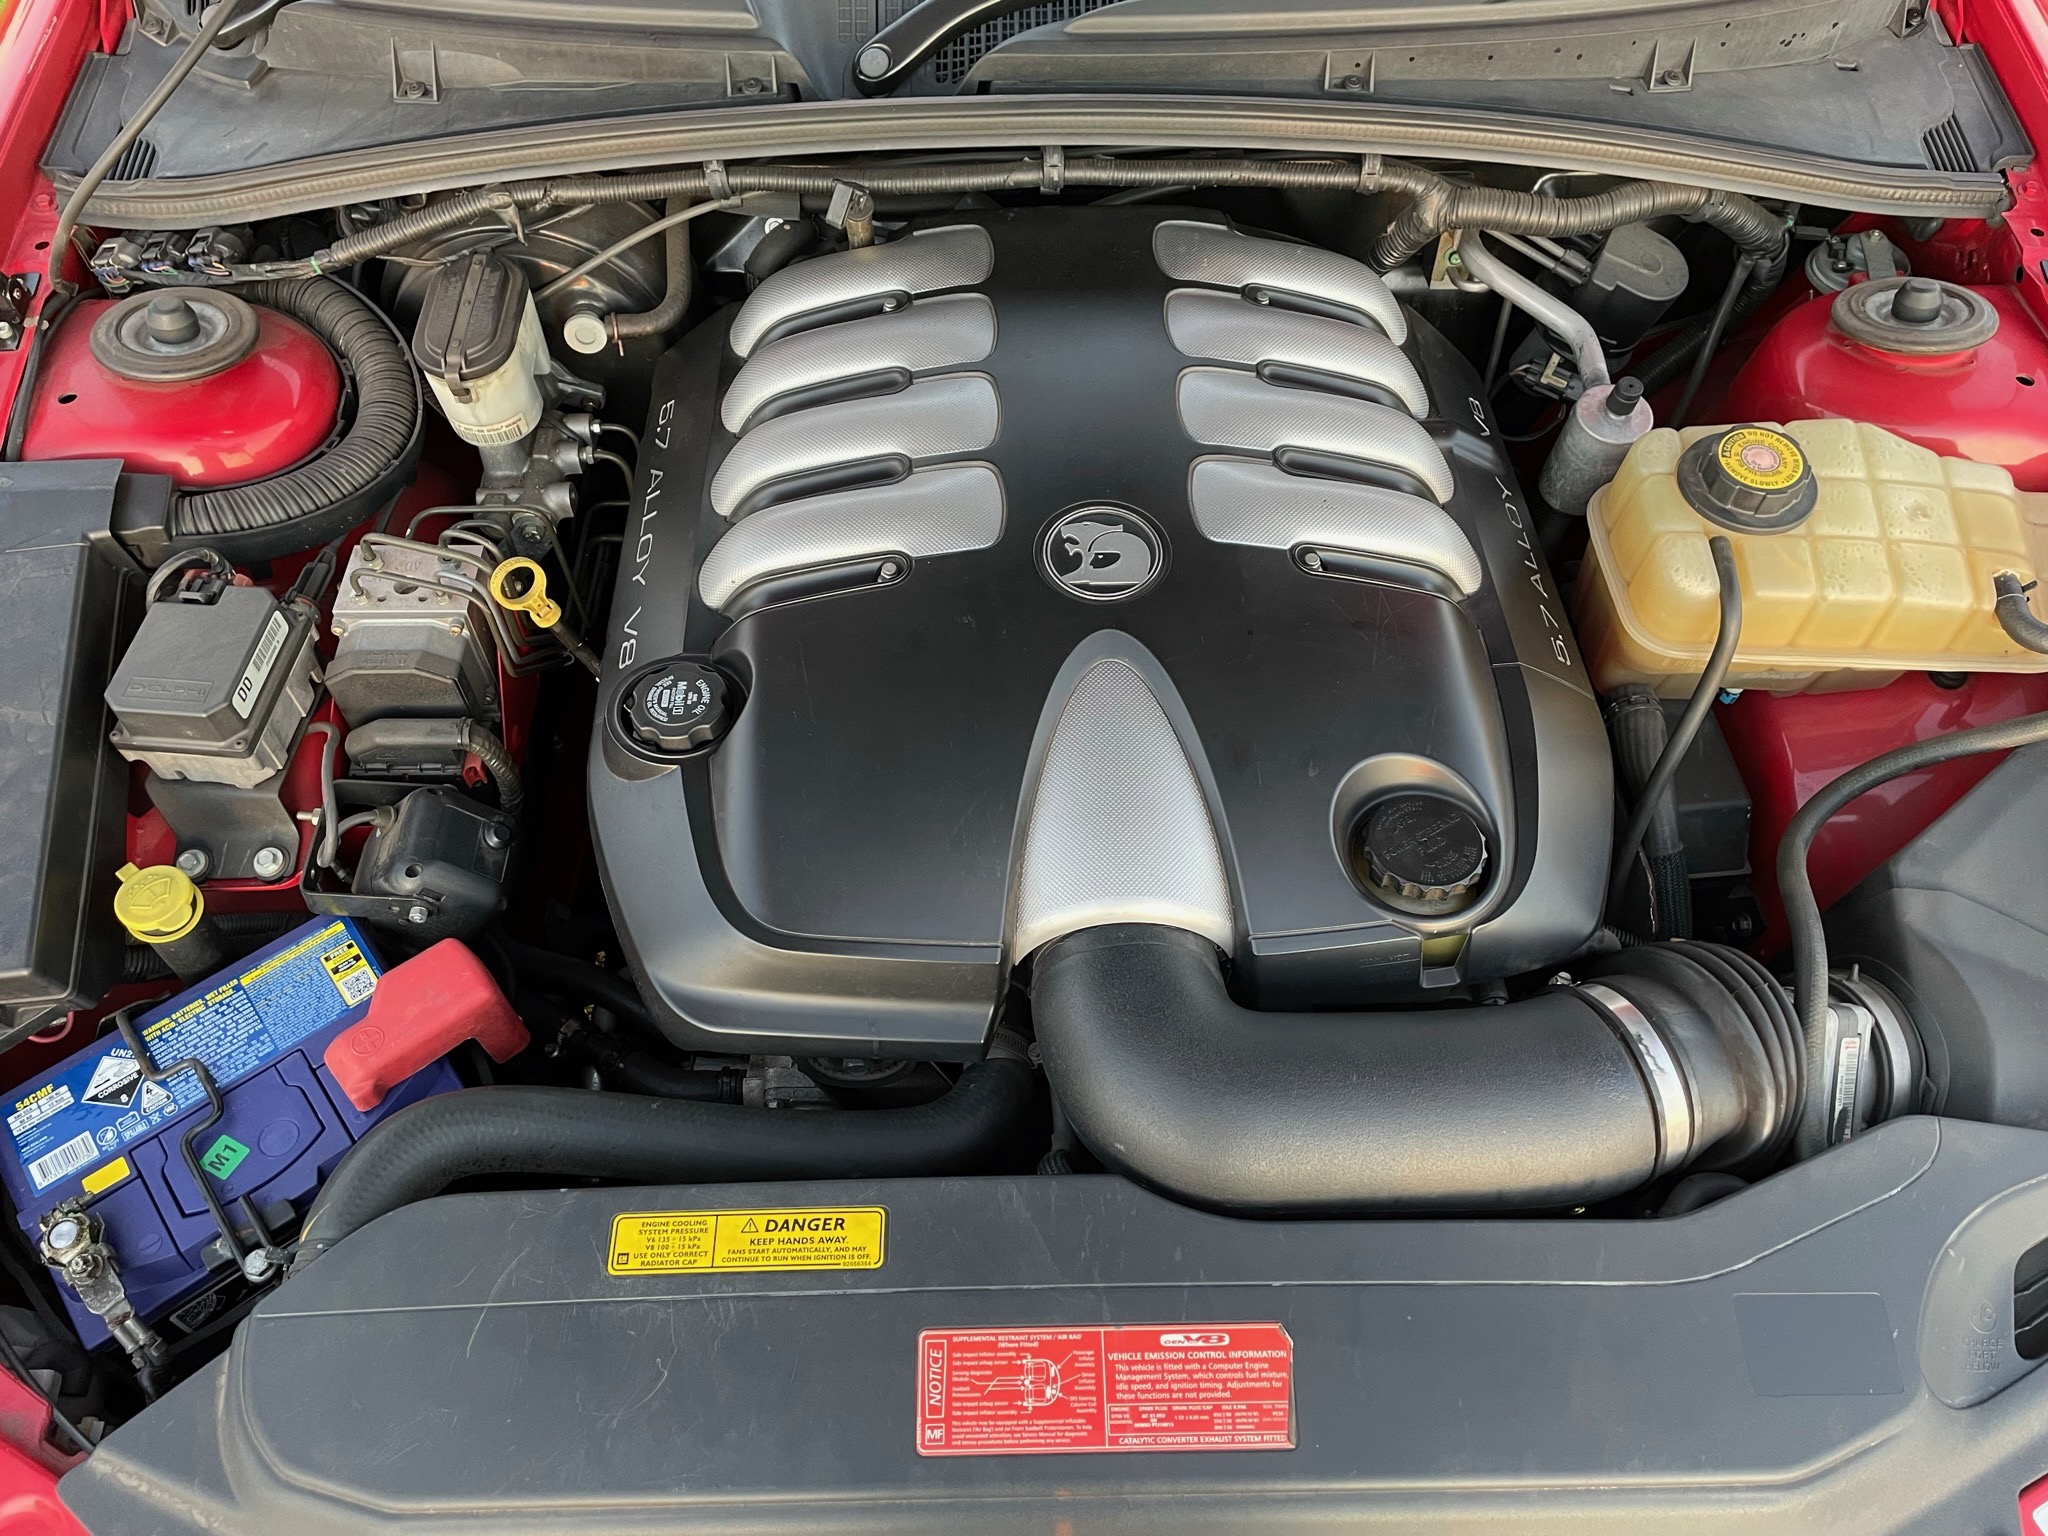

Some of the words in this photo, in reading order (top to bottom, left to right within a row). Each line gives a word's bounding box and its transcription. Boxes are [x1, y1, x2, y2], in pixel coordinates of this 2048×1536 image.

[1468, 398, 1491, 436] V8
[656, 400, 675, 449] 5.7
[1724, 433, 1744, 450] CAUTION
[1760, 431, 1774, 439] NOT
[1775, 438, 1797, 457] REMOVE
[1768, 443, 1787, 469] COOLANT
[1725, 462, 1746, 480] REMOVE
[1792, 459, 1800, 473] WHEN
[1784, 474, 1795, 482] HOT
[632, 469, 664, 586] ALLOY
[1495, 476, 1548, 599] ALLOY
[618, 606, 642, 669] V8
[1540, 604, 1571, 666] 5.7
[655, 675, 674, 686] SPECIAL
[237, 677, 252, 702] DD
[674, 682, 687, 706] Mobil
[696, 679, 710, 704] ENGINE
[653, 704, 667, 717] MANUAL
[692, 705, 705, 714] OIL
[1383, 838, 1417, 860] POWER
[1416, 813, 1461, 841] STEERING
[330, 946, 348, 958] FREE
[142, 1017, 172, 1036] WARNING:
[171, 998, 205, 1020] BATTERIES,
[205, 990, 219, 1000] WET
[218, 979, 238, 993] FILLED
[145, 1030, 161, 1041] WITH
[178, 1005, 206, 1023] ELECTRIC
[207, 988, 236, 1006] STORAGE.
[98, 1072, 139, 1098] CORROSIVE
[15, 1083, 54, 1112] 54CMF
[120, 1094, 129, 1103] 8
[146, 1098, 168, 1112] CAUTION
[123, 1121, 147, 1140] SPILLABLE
[208, 1144, 237, 1171] M1
[765, 1218, 845, 1232] DANGER
[750, 1238, 774, 1246] KEEP
[778, 1237, 814, 1245] HANDS
[818, 1236, 849, 1244] AWAY.
[1184, 1335, 1226, 1343] V8
[1962, 1338, 2003, 1349] CHARGE
[1229, 1350, 1287, 1358] INFORMATION
[1969, 1350, 1996, 1360] PORT
[1209, 1362, 1242, 1371] Computer
[1245, 1362, 1269, 1370] Engine
[1966, 1362, 2000, 1372] BELOW
[929, 1349, 942, 1405] NOTICE
[1116, 1373, 1162, 1382] Management
[1164, 1373, 1190, 1381] System,
[1116, 1382, 1128, 1390] idle
[1131, 1383, 1153, 1391] speed,
[1171, 1382, 1198, 1390] ignition
[1200, 1382, 1224, 1390] timing.
[1227, 1380, 1270, 1389] Adjustments
[1272, 1380, 1282, 1388] for
[1200, 1391, 1231, 1399] provided.
[927, 1429, 943, 1439] MF
[1157, 1436, 1198, 1444] CONVERTER
